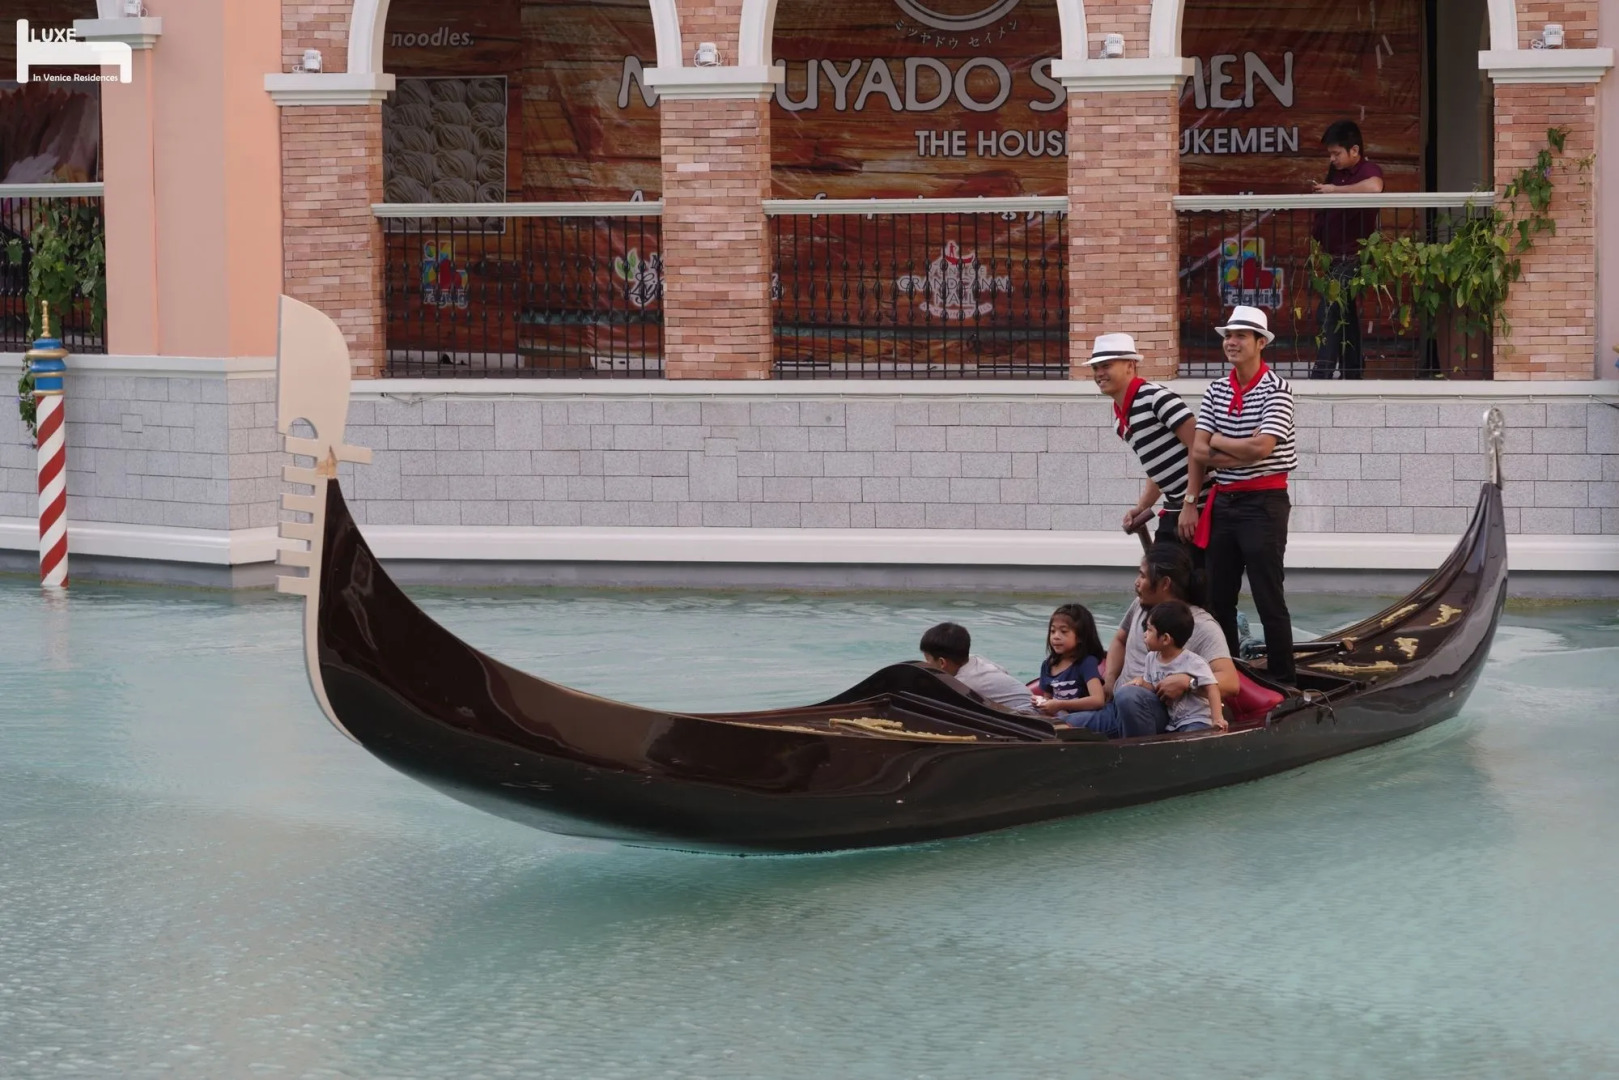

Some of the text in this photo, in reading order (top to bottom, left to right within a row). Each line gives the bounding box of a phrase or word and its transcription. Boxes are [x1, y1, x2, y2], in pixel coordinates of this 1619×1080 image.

[391, 26, 475, 47] noodles.
[914, 130, 967, 156] THE
[977, 129, 1069, 157] HOUS
